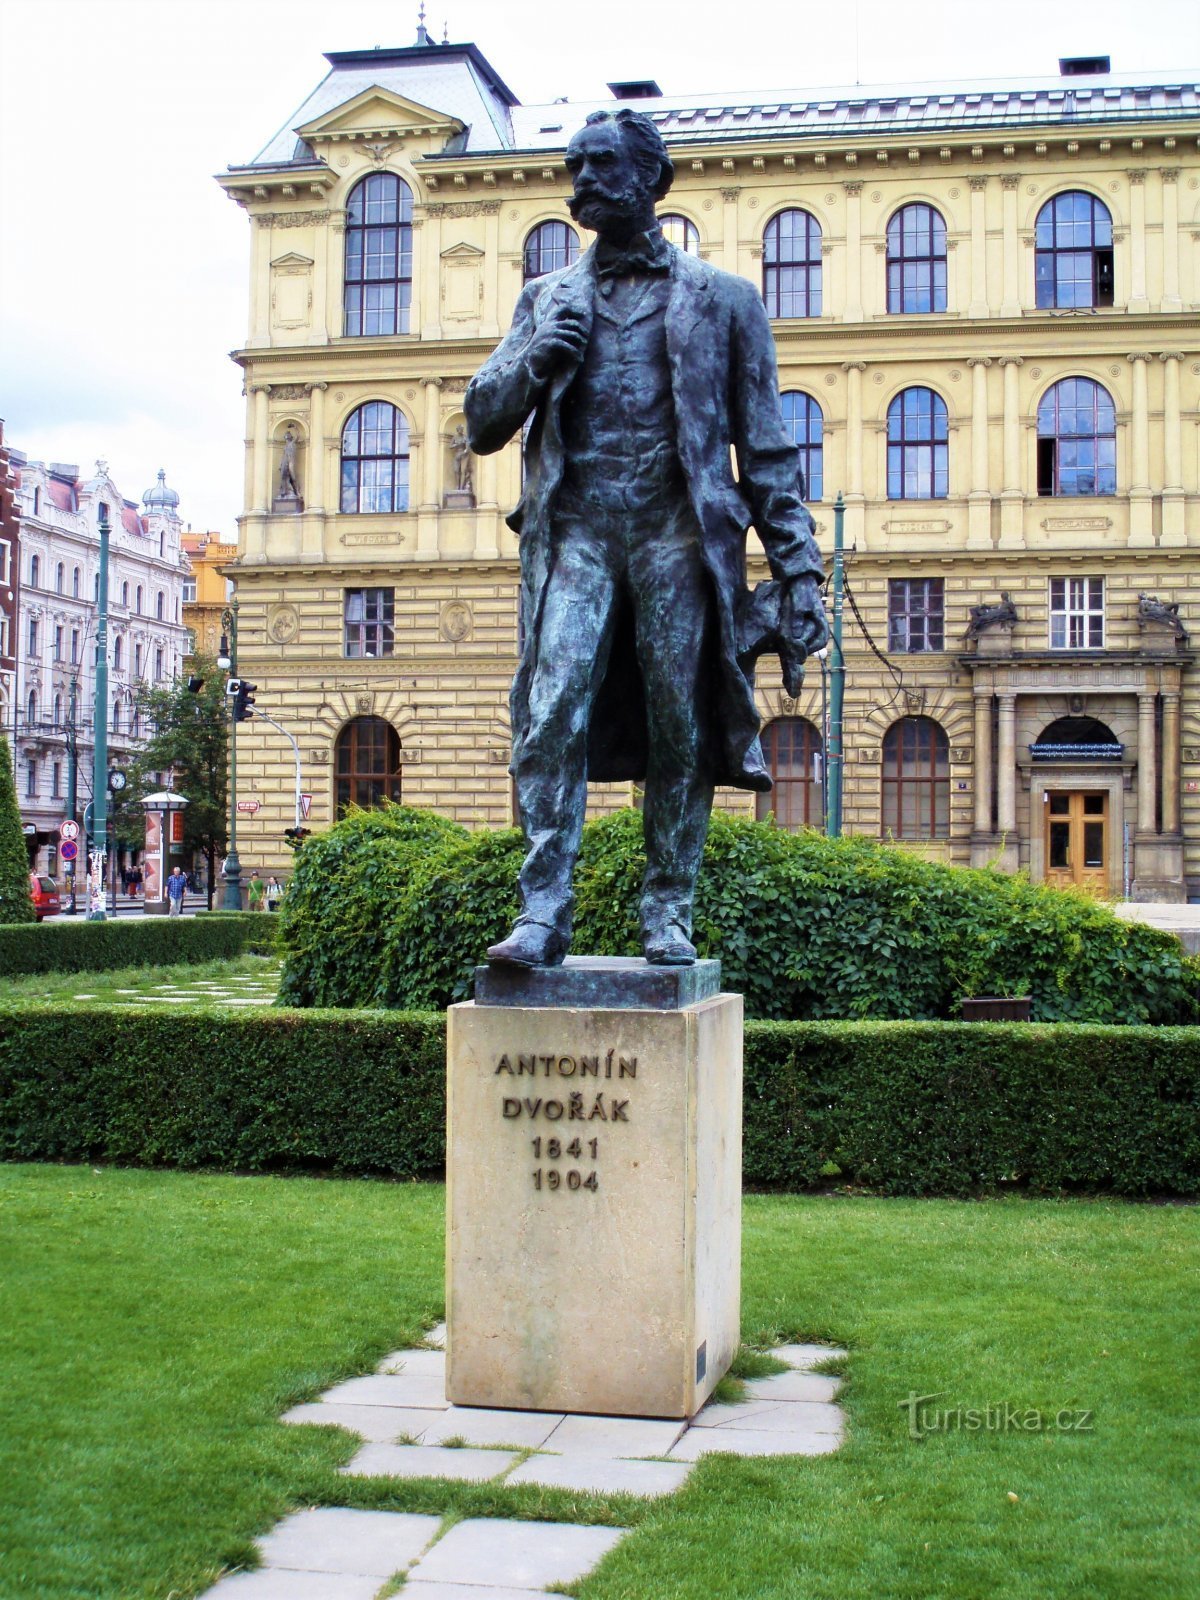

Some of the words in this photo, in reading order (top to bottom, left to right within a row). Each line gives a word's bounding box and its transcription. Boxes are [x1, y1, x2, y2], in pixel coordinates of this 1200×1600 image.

[495, 1048, 637, 1078] ANTONÍN
[503, 1091, 629, 1121] DVOŘÁK
[532, 1136, 598, 1159] 1841
[532, 1168, 599, 1192] 1904
